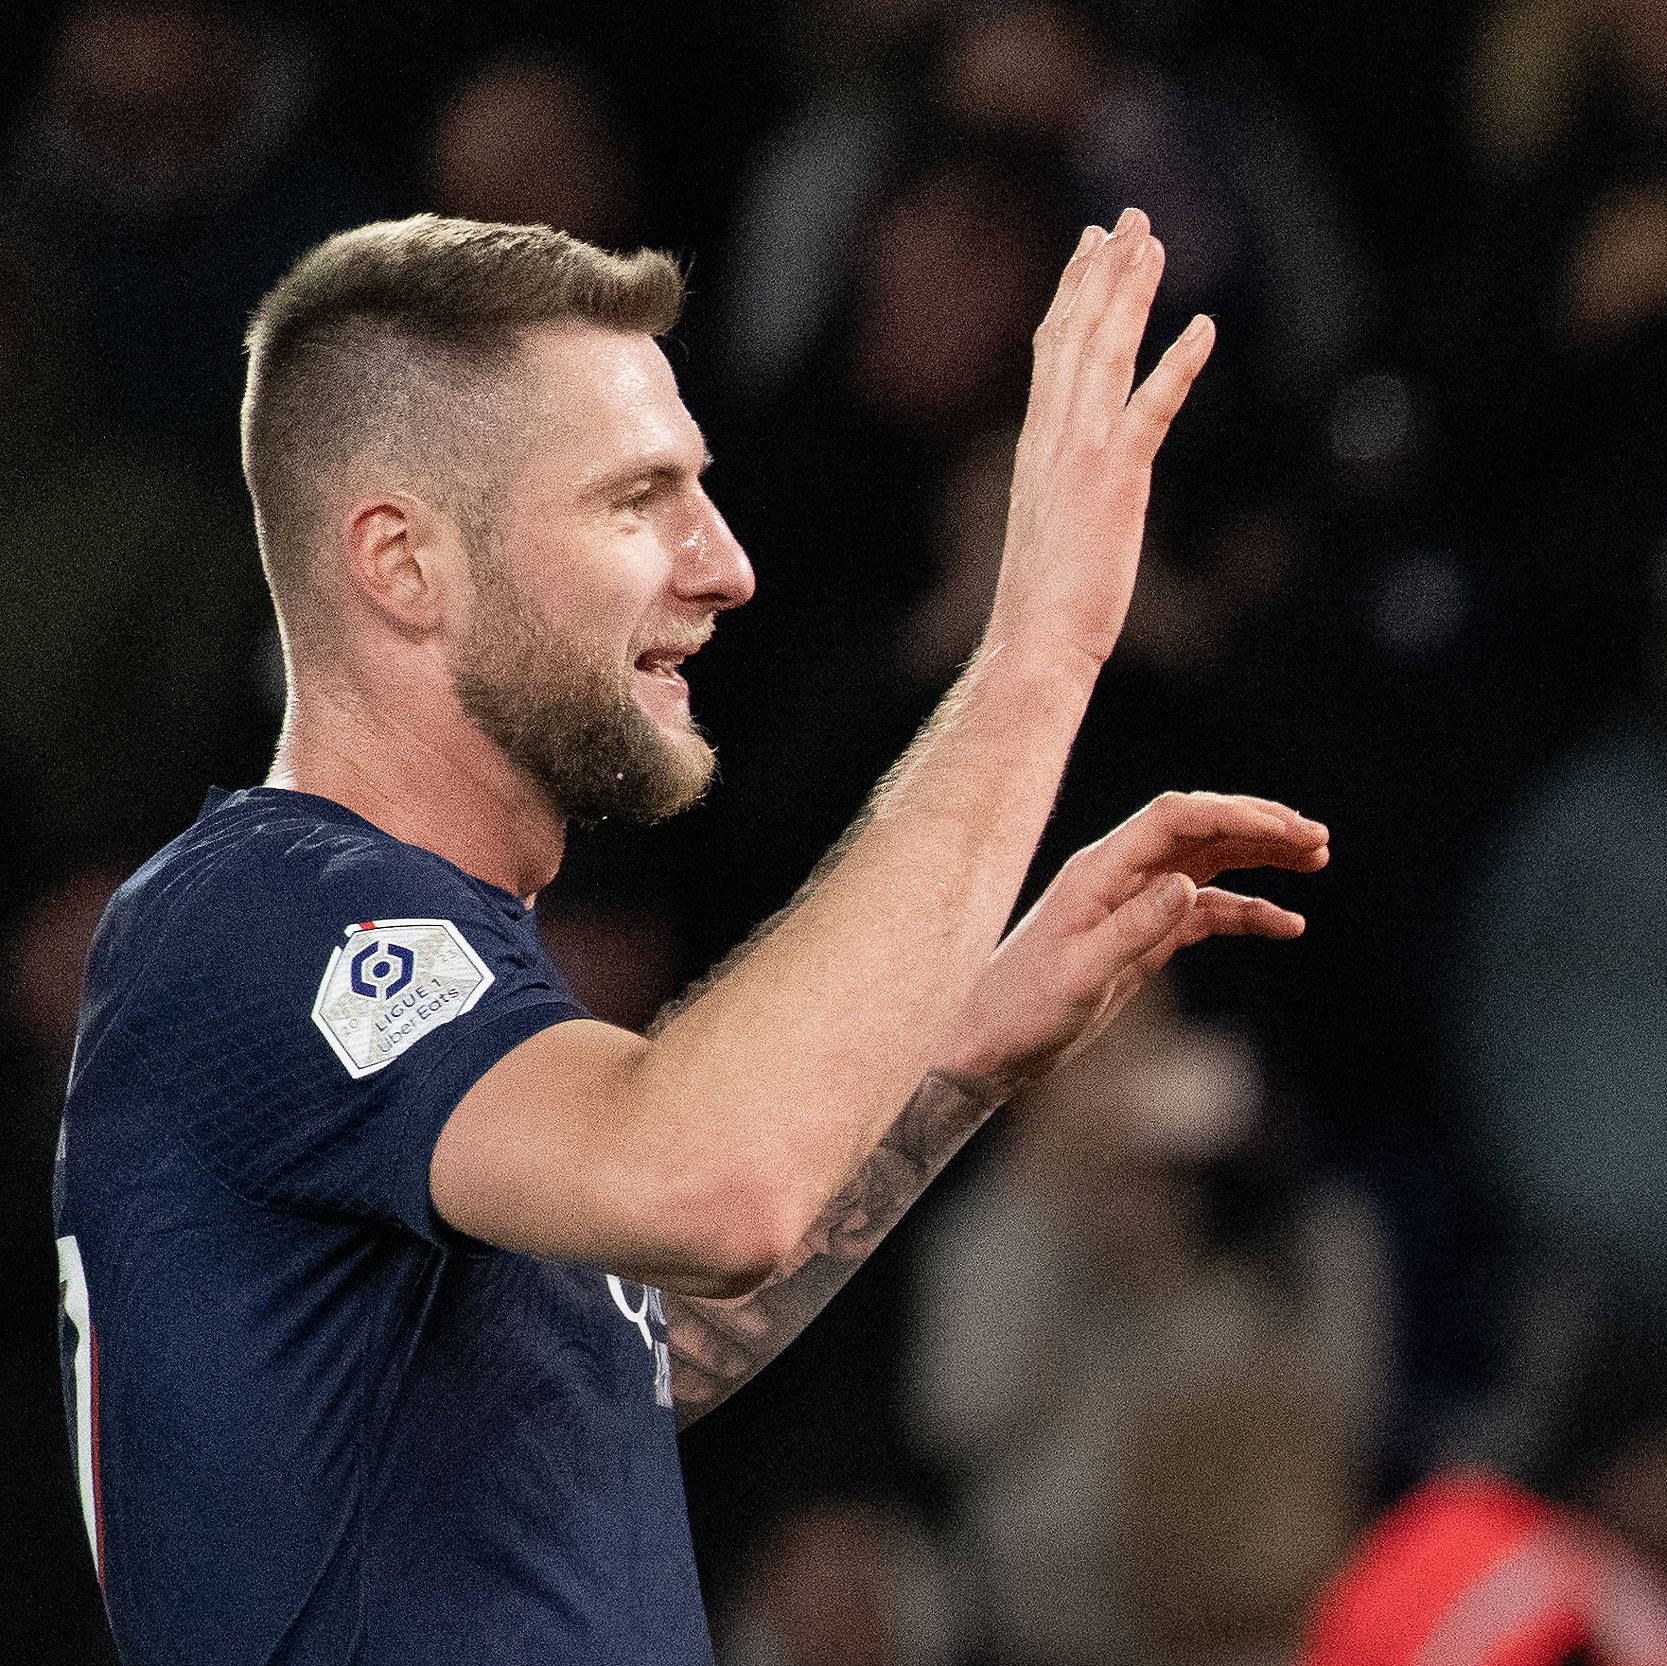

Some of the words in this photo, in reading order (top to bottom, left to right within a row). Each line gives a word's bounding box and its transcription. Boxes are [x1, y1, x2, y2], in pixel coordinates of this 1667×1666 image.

[375, 985, 429, 1032] LIGUE
[376, 1017, 416, 1053] Uber
[416, 989, 459, 1020] Eats
